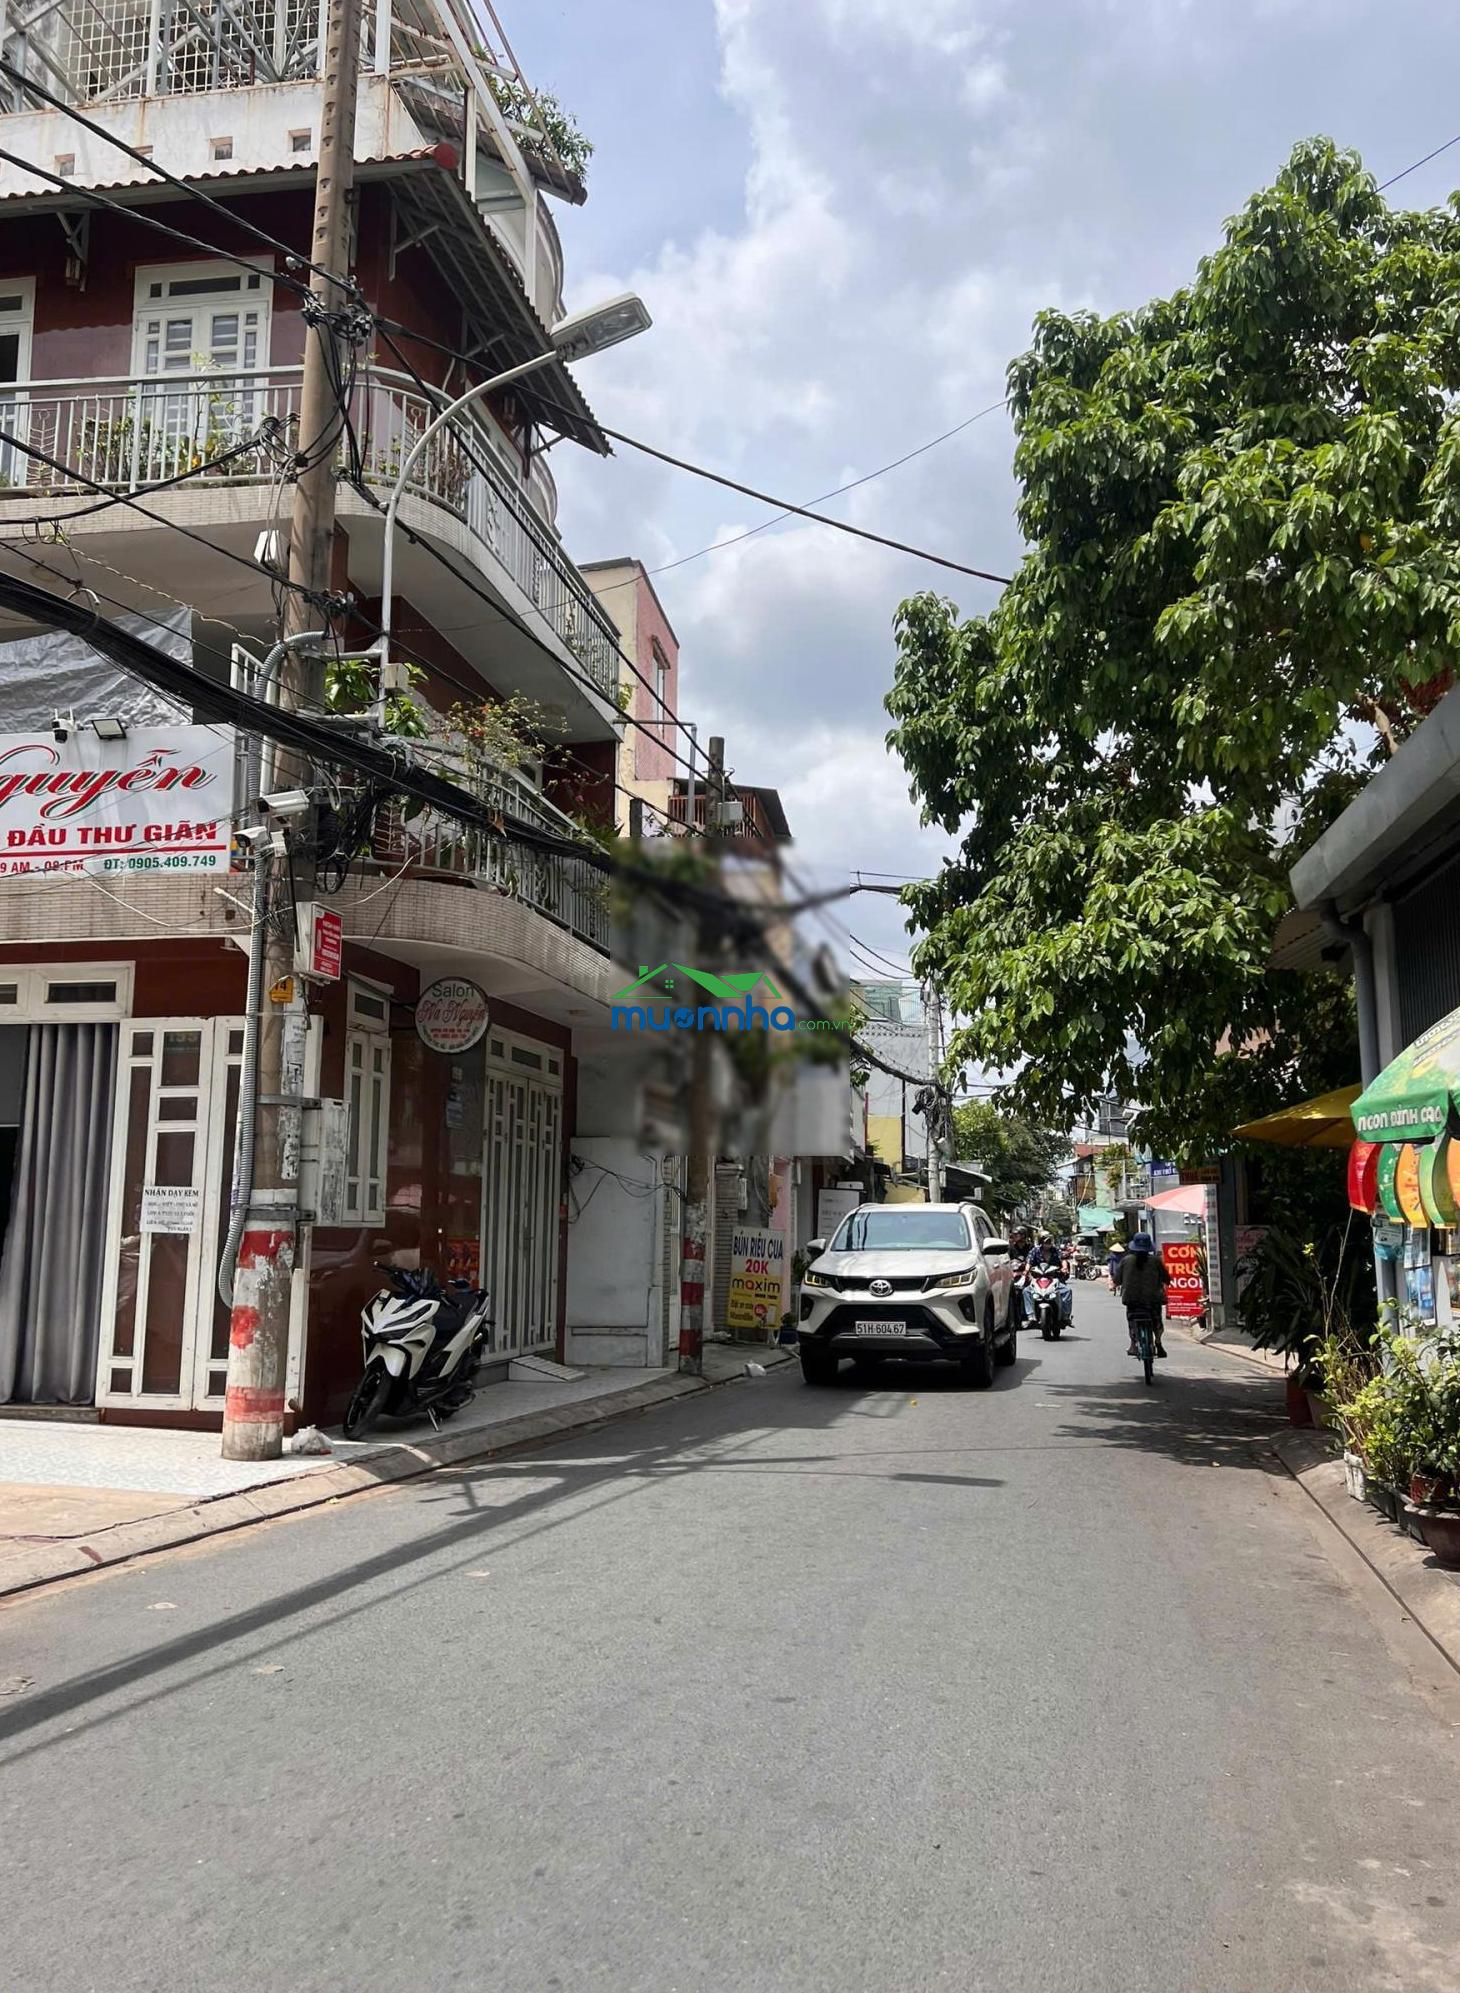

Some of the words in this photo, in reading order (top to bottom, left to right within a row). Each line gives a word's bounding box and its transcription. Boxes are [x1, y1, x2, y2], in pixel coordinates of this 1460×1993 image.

[7, 823, 67, 847] ĐẦU
[77, 823, 137, 844] THƯ
[144, 820, 217, 842] GIÃN
[11, 861, 30, 872] AM
[128, 855, 216, 869] 0905.409.749
[432, 983, 474, 998] Salon
[733, 1230, 749, 1257] BÚN
[767, 1239, 784, 1260] CUA
[745, 1258, 769, 1275] 20K
[732, 1278, 781, 1294] maxim
